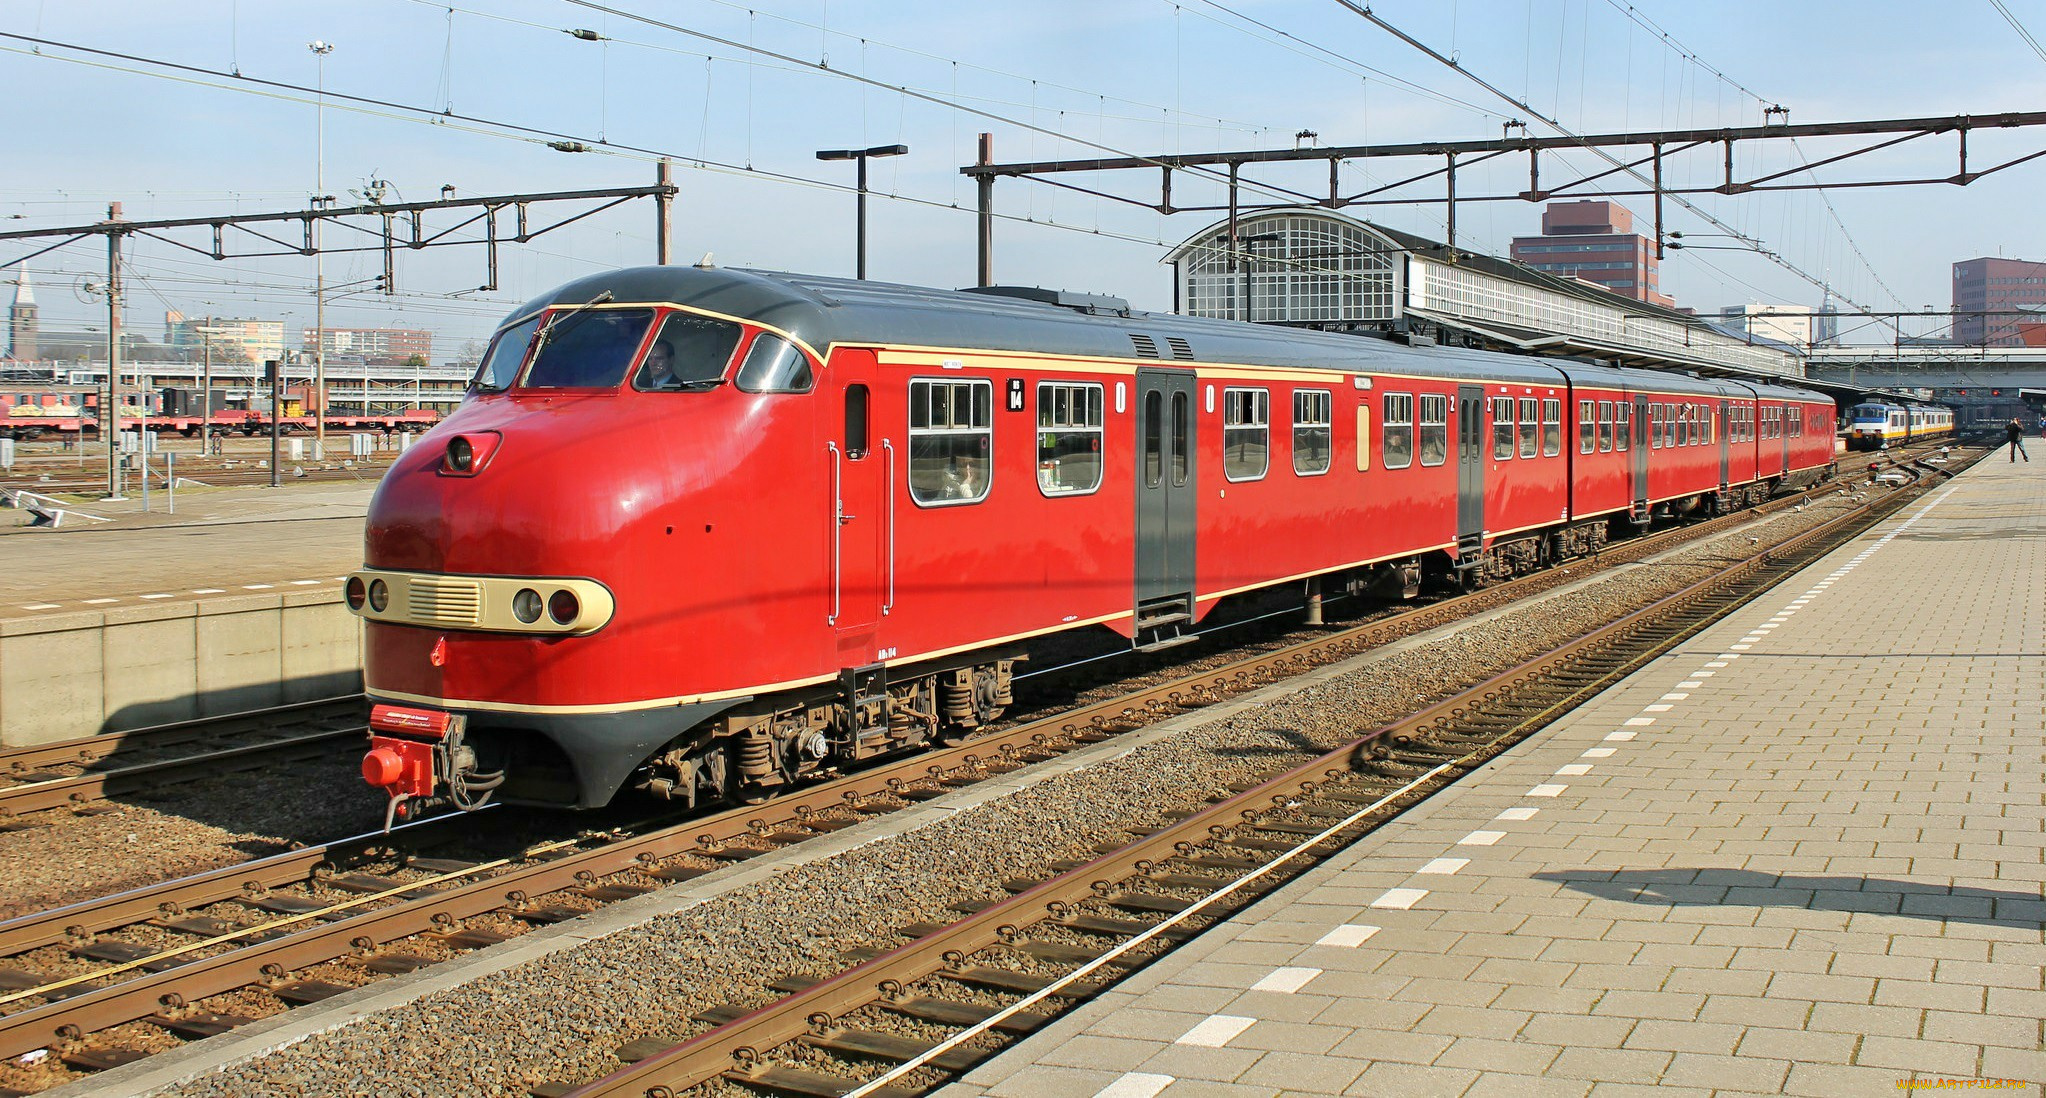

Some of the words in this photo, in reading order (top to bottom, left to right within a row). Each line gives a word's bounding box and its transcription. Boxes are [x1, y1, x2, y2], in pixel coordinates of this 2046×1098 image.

[1010, 390, 1022, 409] 114
[1450, 395, 1455, 412] 2
[1486, 396, 1491, 412] 2
